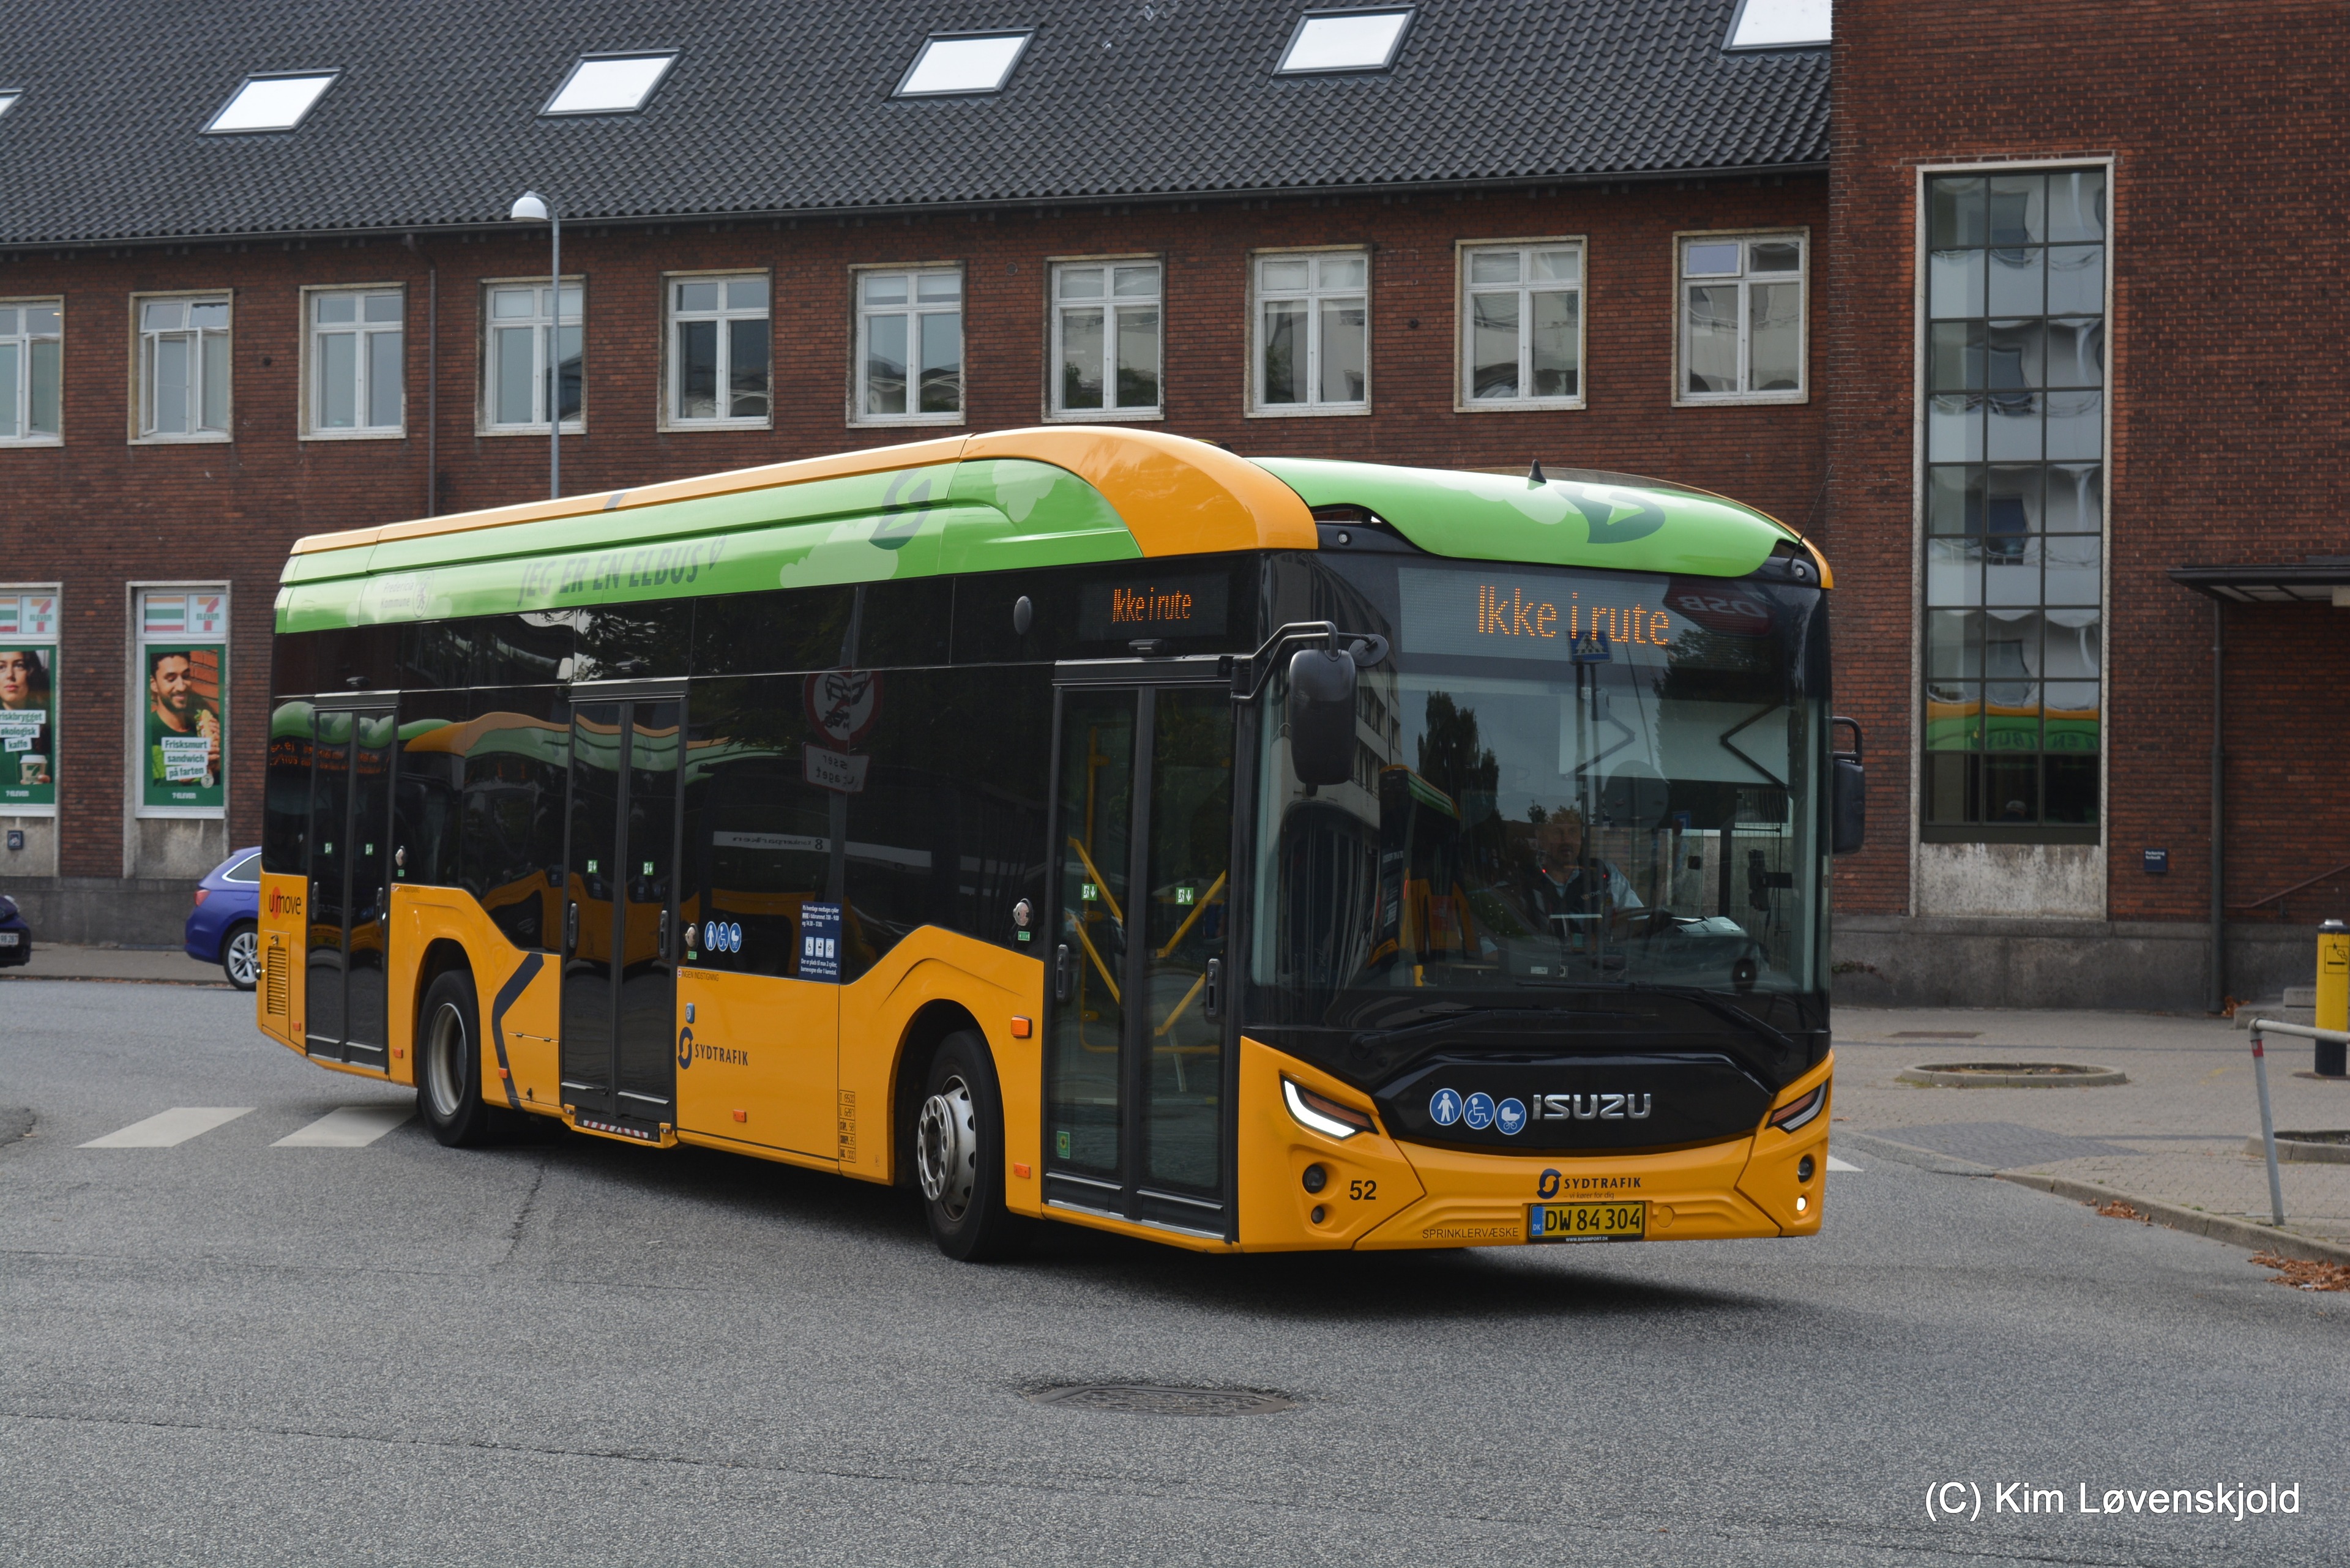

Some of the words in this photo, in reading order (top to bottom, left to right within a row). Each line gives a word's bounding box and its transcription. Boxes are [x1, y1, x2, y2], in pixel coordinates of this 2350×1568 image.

[517, 561, 556, 607] JEG
[559, 558, 589, 593] ER
[592, 553, 625, 590] EN
[629, 544, 704, 588] ELBUS
[1113, 588, 1145, 622] Ikke
[1149, 587, 1154, 621] i
[1157, 590, 1192, 620] rute
[1479, 585, 1556, 638] Ikke
[1571, 592, 1578, 639] i
[1591, 604, 1670, 645] rute
[165, 740, 207, 749] Frisksmurt
[169, 767, 178, 779] på
[180, 767, 204, 776] farten
[269, 893, 301, 916] umove
[695, 1043, 748, 1066] SYDTRAFIK
[1532, 1094, 1651, 1120] ISUZU
[1349, 1180, 1377, 1200] 52
[1564, 1177, 1641, 1189] SYDTRAFIK
[1605, 1191, 1614, 1200] dig
[1545, 1209, 1572, 1231] DW
[1576, 1208, 1600, 1231] 84
[1605, 1208, 1640, 1230] 304
[1422, 1228, 1518, 1239] SPRINKLERVÆSKE
